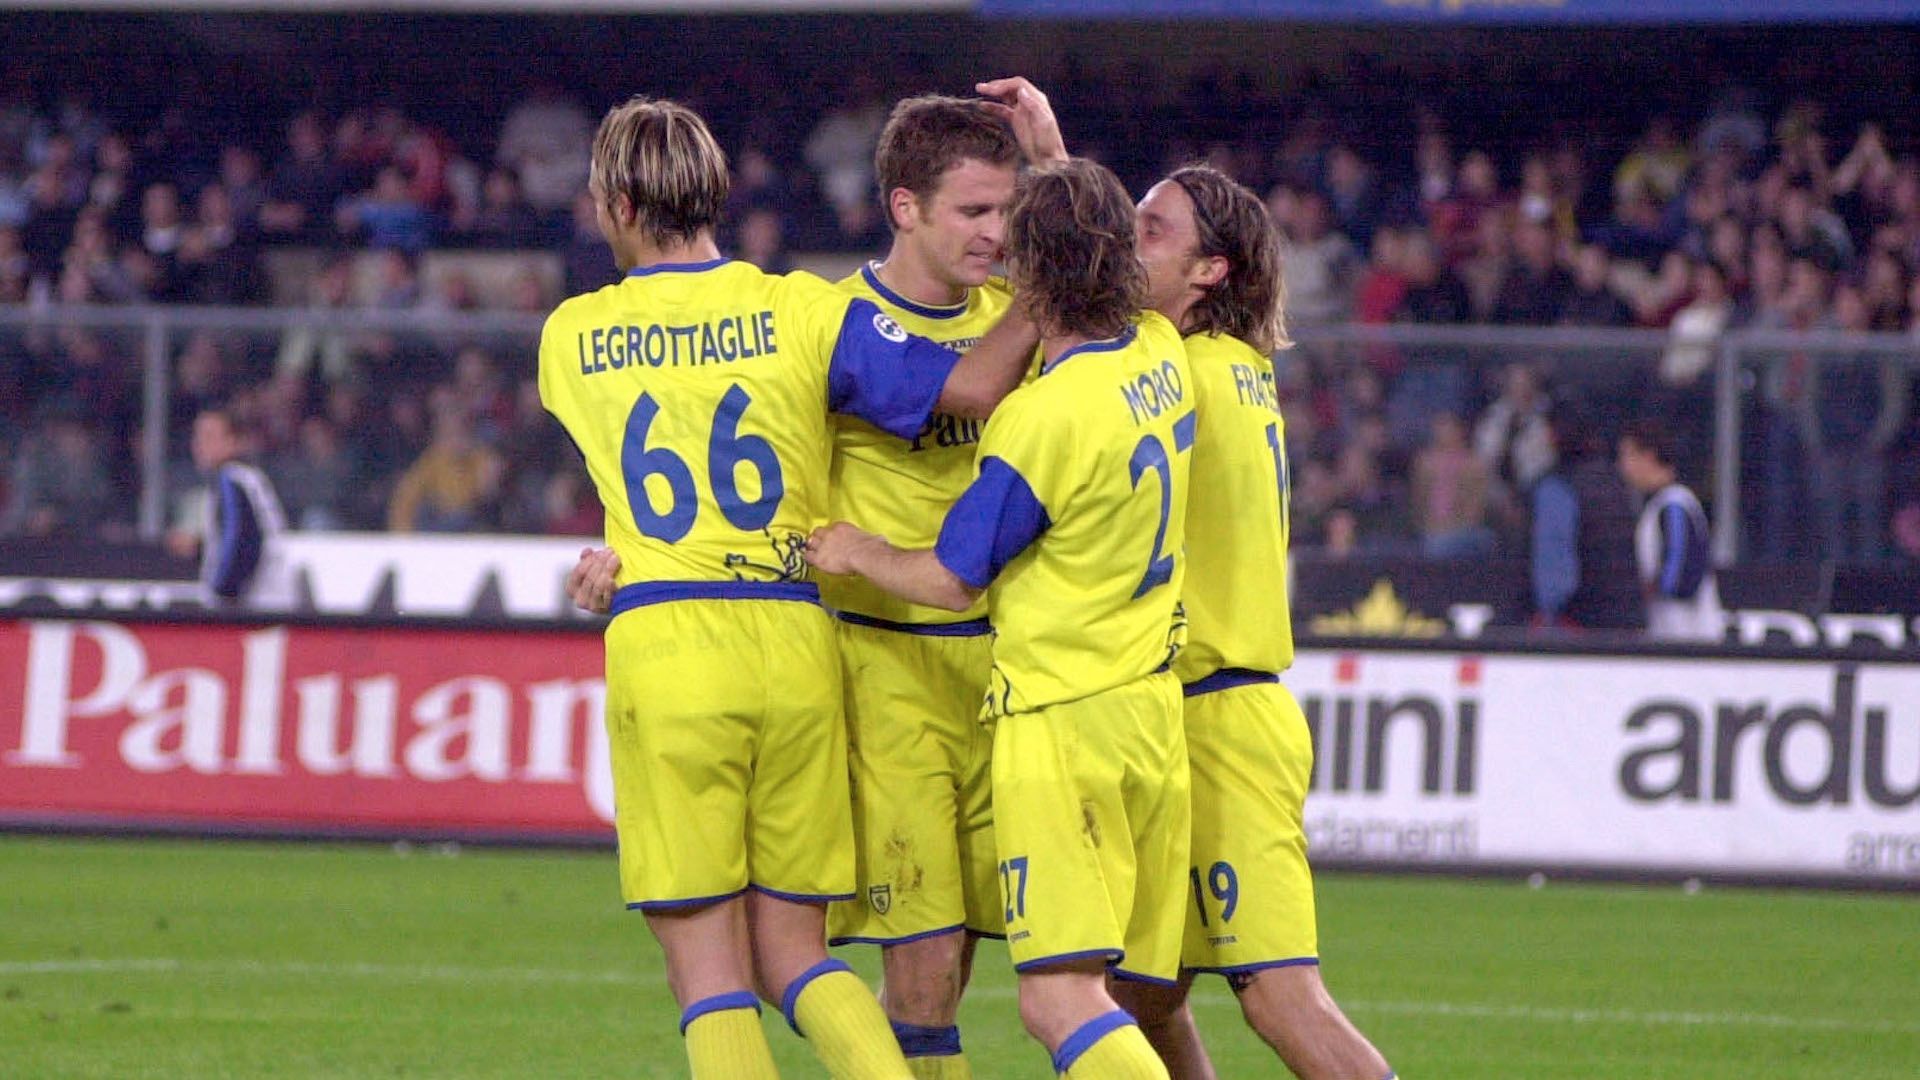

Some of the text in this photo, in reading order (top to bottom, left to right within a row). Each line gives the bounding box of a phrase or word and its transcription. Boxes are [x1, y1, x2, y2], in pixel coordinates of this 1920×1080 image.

[578, 310, 777, 375] LEGROTTAGLIE
[1120, 360, 1183, 425] MORO
[621, 383, 784, 544] 66
[1000, 856, 1028, 924] 27
[1190, 861, 1238, 927] 19
